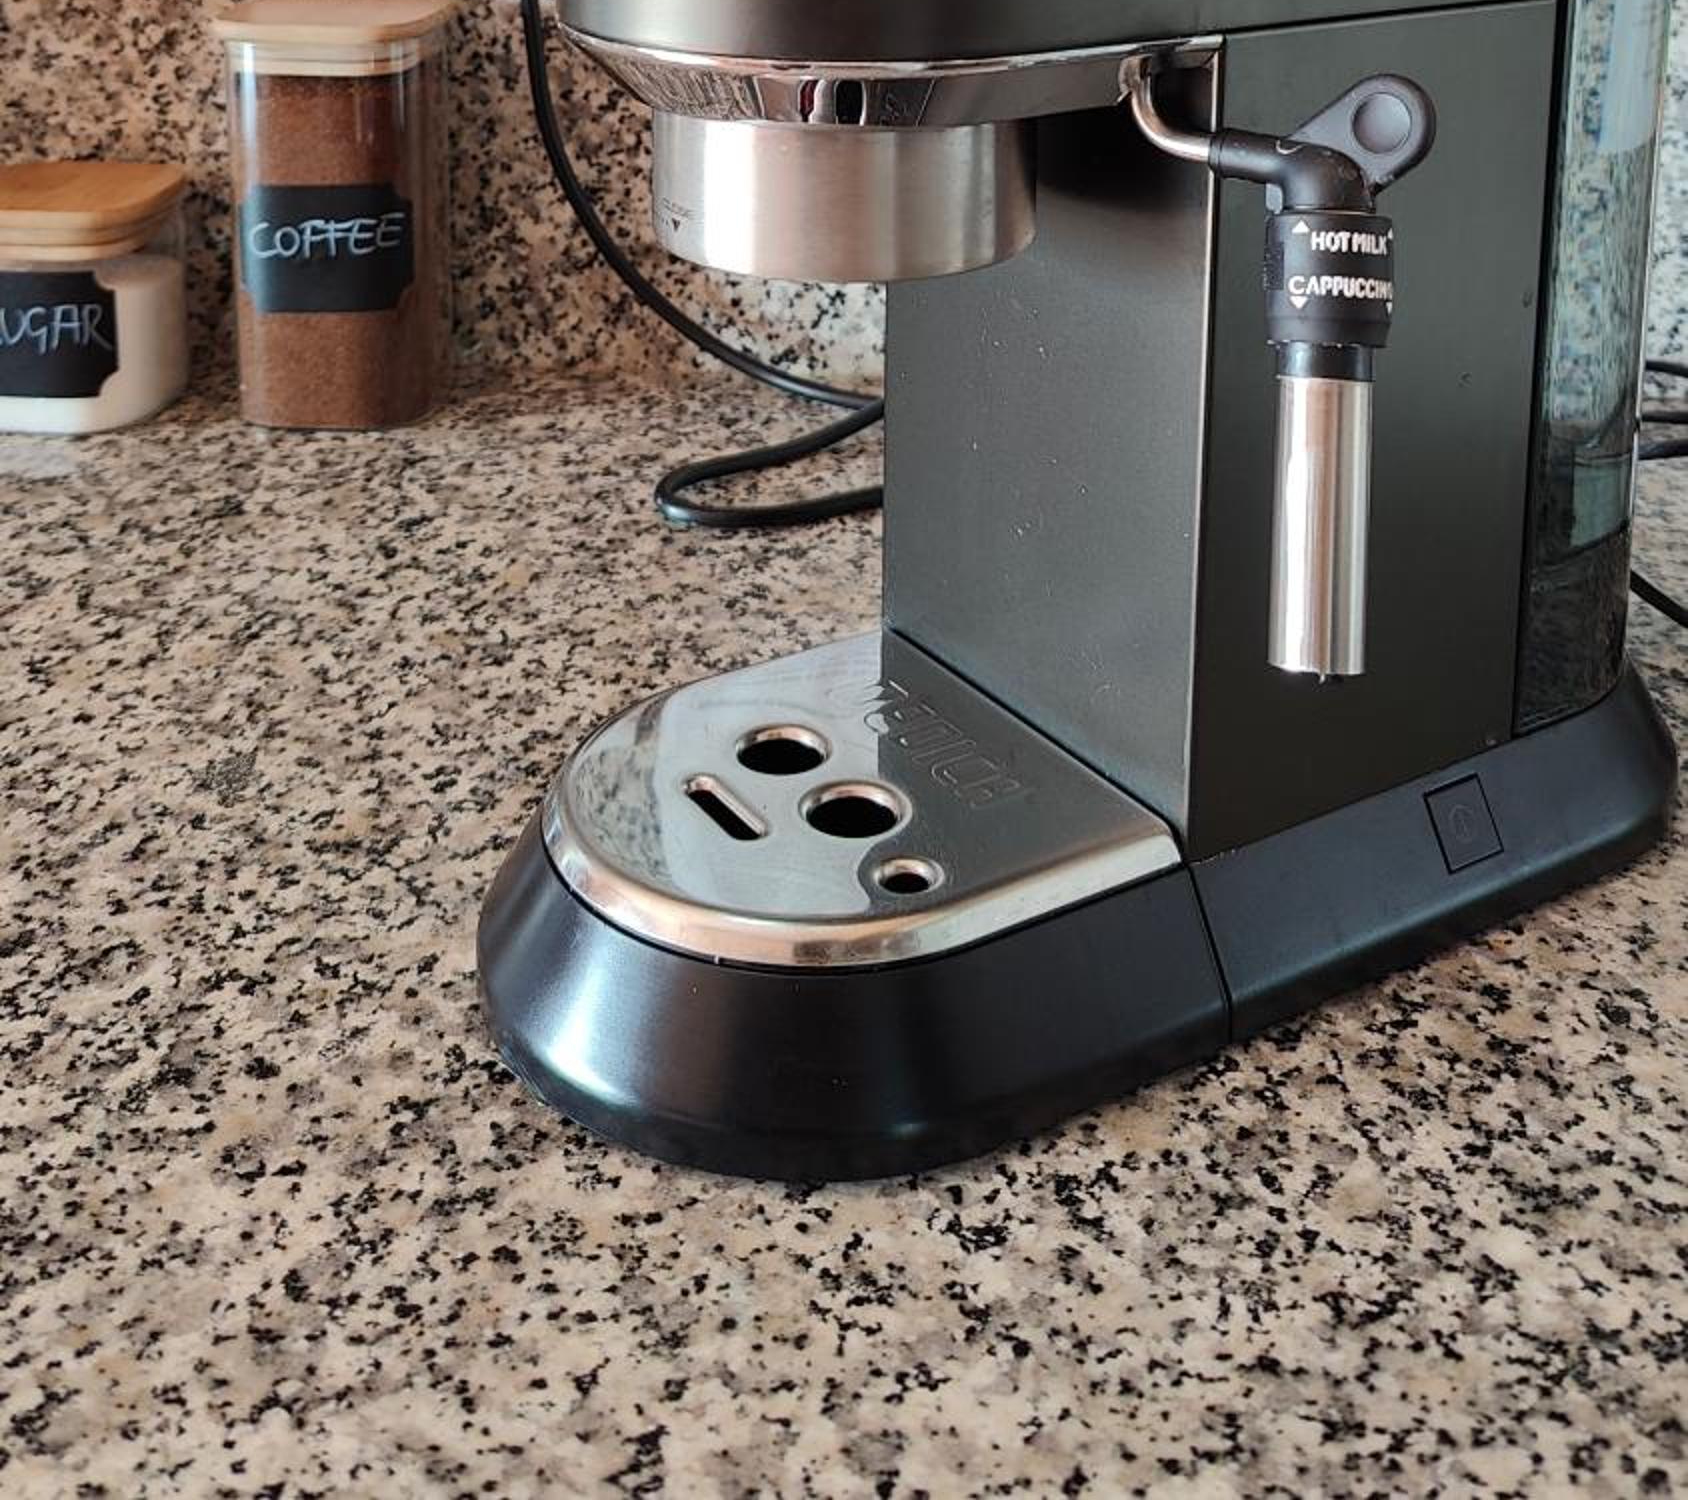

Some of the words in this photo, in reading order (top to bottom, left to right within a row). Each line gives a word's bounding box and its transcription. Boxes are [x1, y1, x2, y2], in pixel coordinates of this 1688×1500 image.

[249, 211, 405, 258] COFFEE
[1311, 231, 1351, 253] HOT
[1351, 232, 1388, 256] MILK
[0, 302, 113, 356] UGAR
